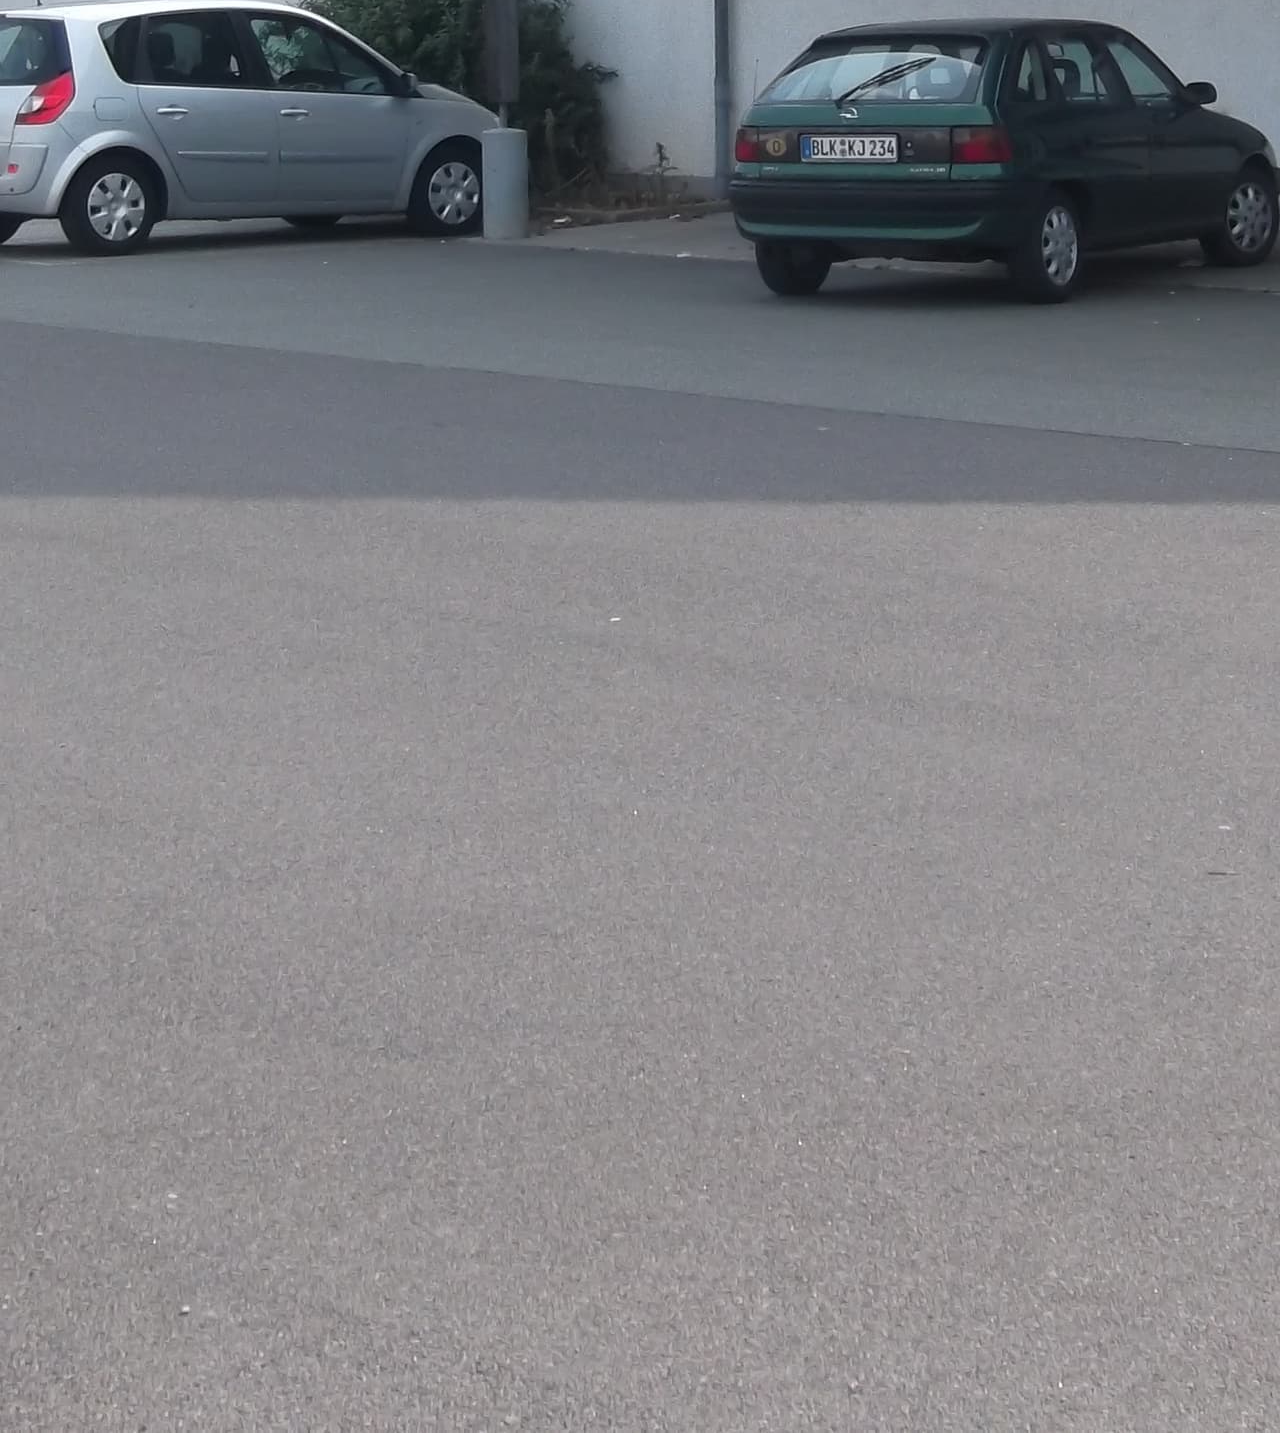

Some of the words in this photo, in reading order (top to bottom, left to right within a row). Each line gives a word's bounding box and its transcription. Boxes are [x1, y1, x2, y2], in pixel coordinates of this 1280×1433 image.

[812, 139, 837, 156] BLK
[848, 139, 865, 156] KJ
[870, 139, 895, 157] 234
